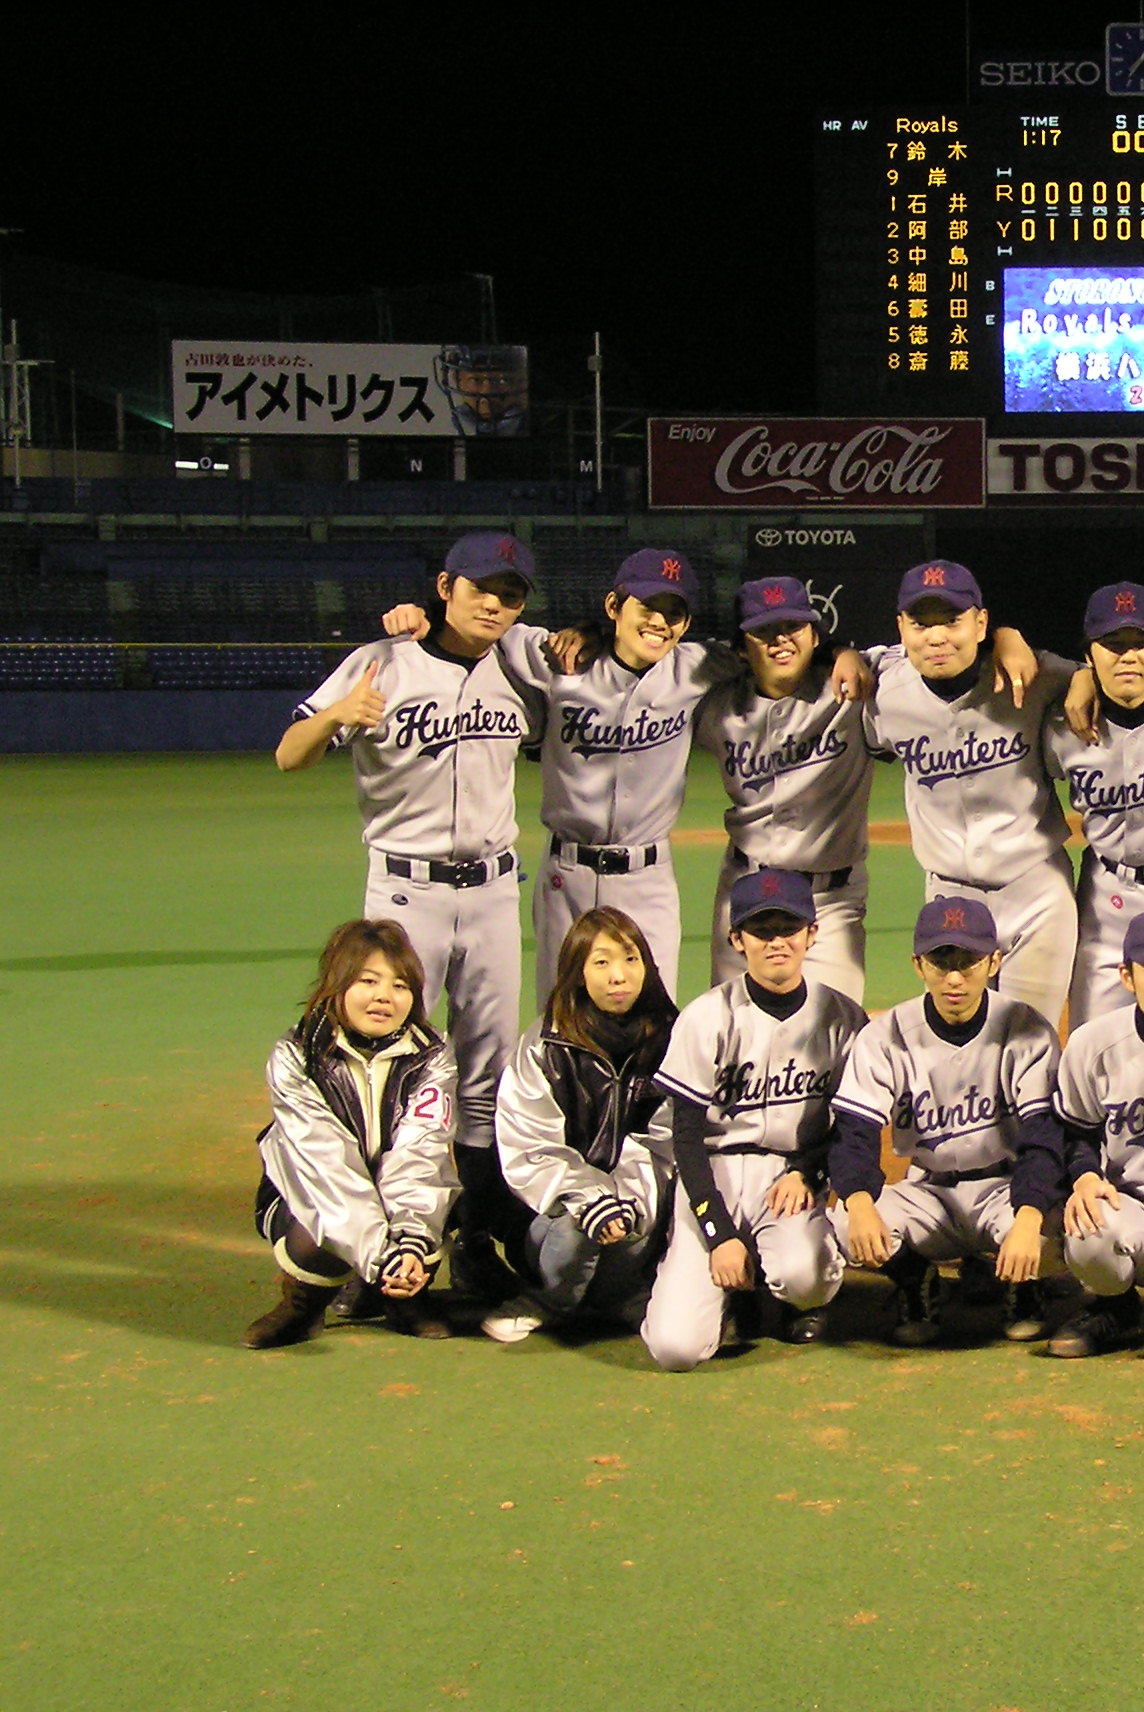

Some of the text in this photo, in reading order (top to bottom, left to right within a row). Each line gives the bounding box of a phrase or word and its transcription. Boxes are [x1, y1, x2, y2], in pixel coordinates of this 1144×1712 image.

[980, 61, 1100, 86] SEIKO
[822, 120, 868, 131] HR AV
[896, 115, 959, 135] Royals
[1020, 116, 1059, 127] TIME
[1023, 129, 1062, 147] 1:17
[886, 142, 899, 160] 7
[886, 166, 948, 188] 9 岸
[995, 184, 1014, 202] R
[890, 195, 897, 212] 1
[887, 221, 899, 239] 2
[996, 220, 1012, 238] Y
[887, 248, 899, 265] 3
[887, 274, 899, 290] 4
[887, 300, 900, 317] 6
[1020, 307, 1133, 336] Royals
[888, 326, 900, 343] 5
[888, 352, 901, 370] 8
[184, 372, 436, 423] アイメトリクス
[668, 424, 716, 443] Enjoy
[410, 459, 423, 472] N
[580, 459, 593, 473] M
[784, 529, 857, 545] TOYOTA
[396, 698, 522, 759] Hunters
[560, 705, 688, 760] Hunters
[725, 729, 848, 792] Hunters
[894, 732, 1031, 791] Hunters
